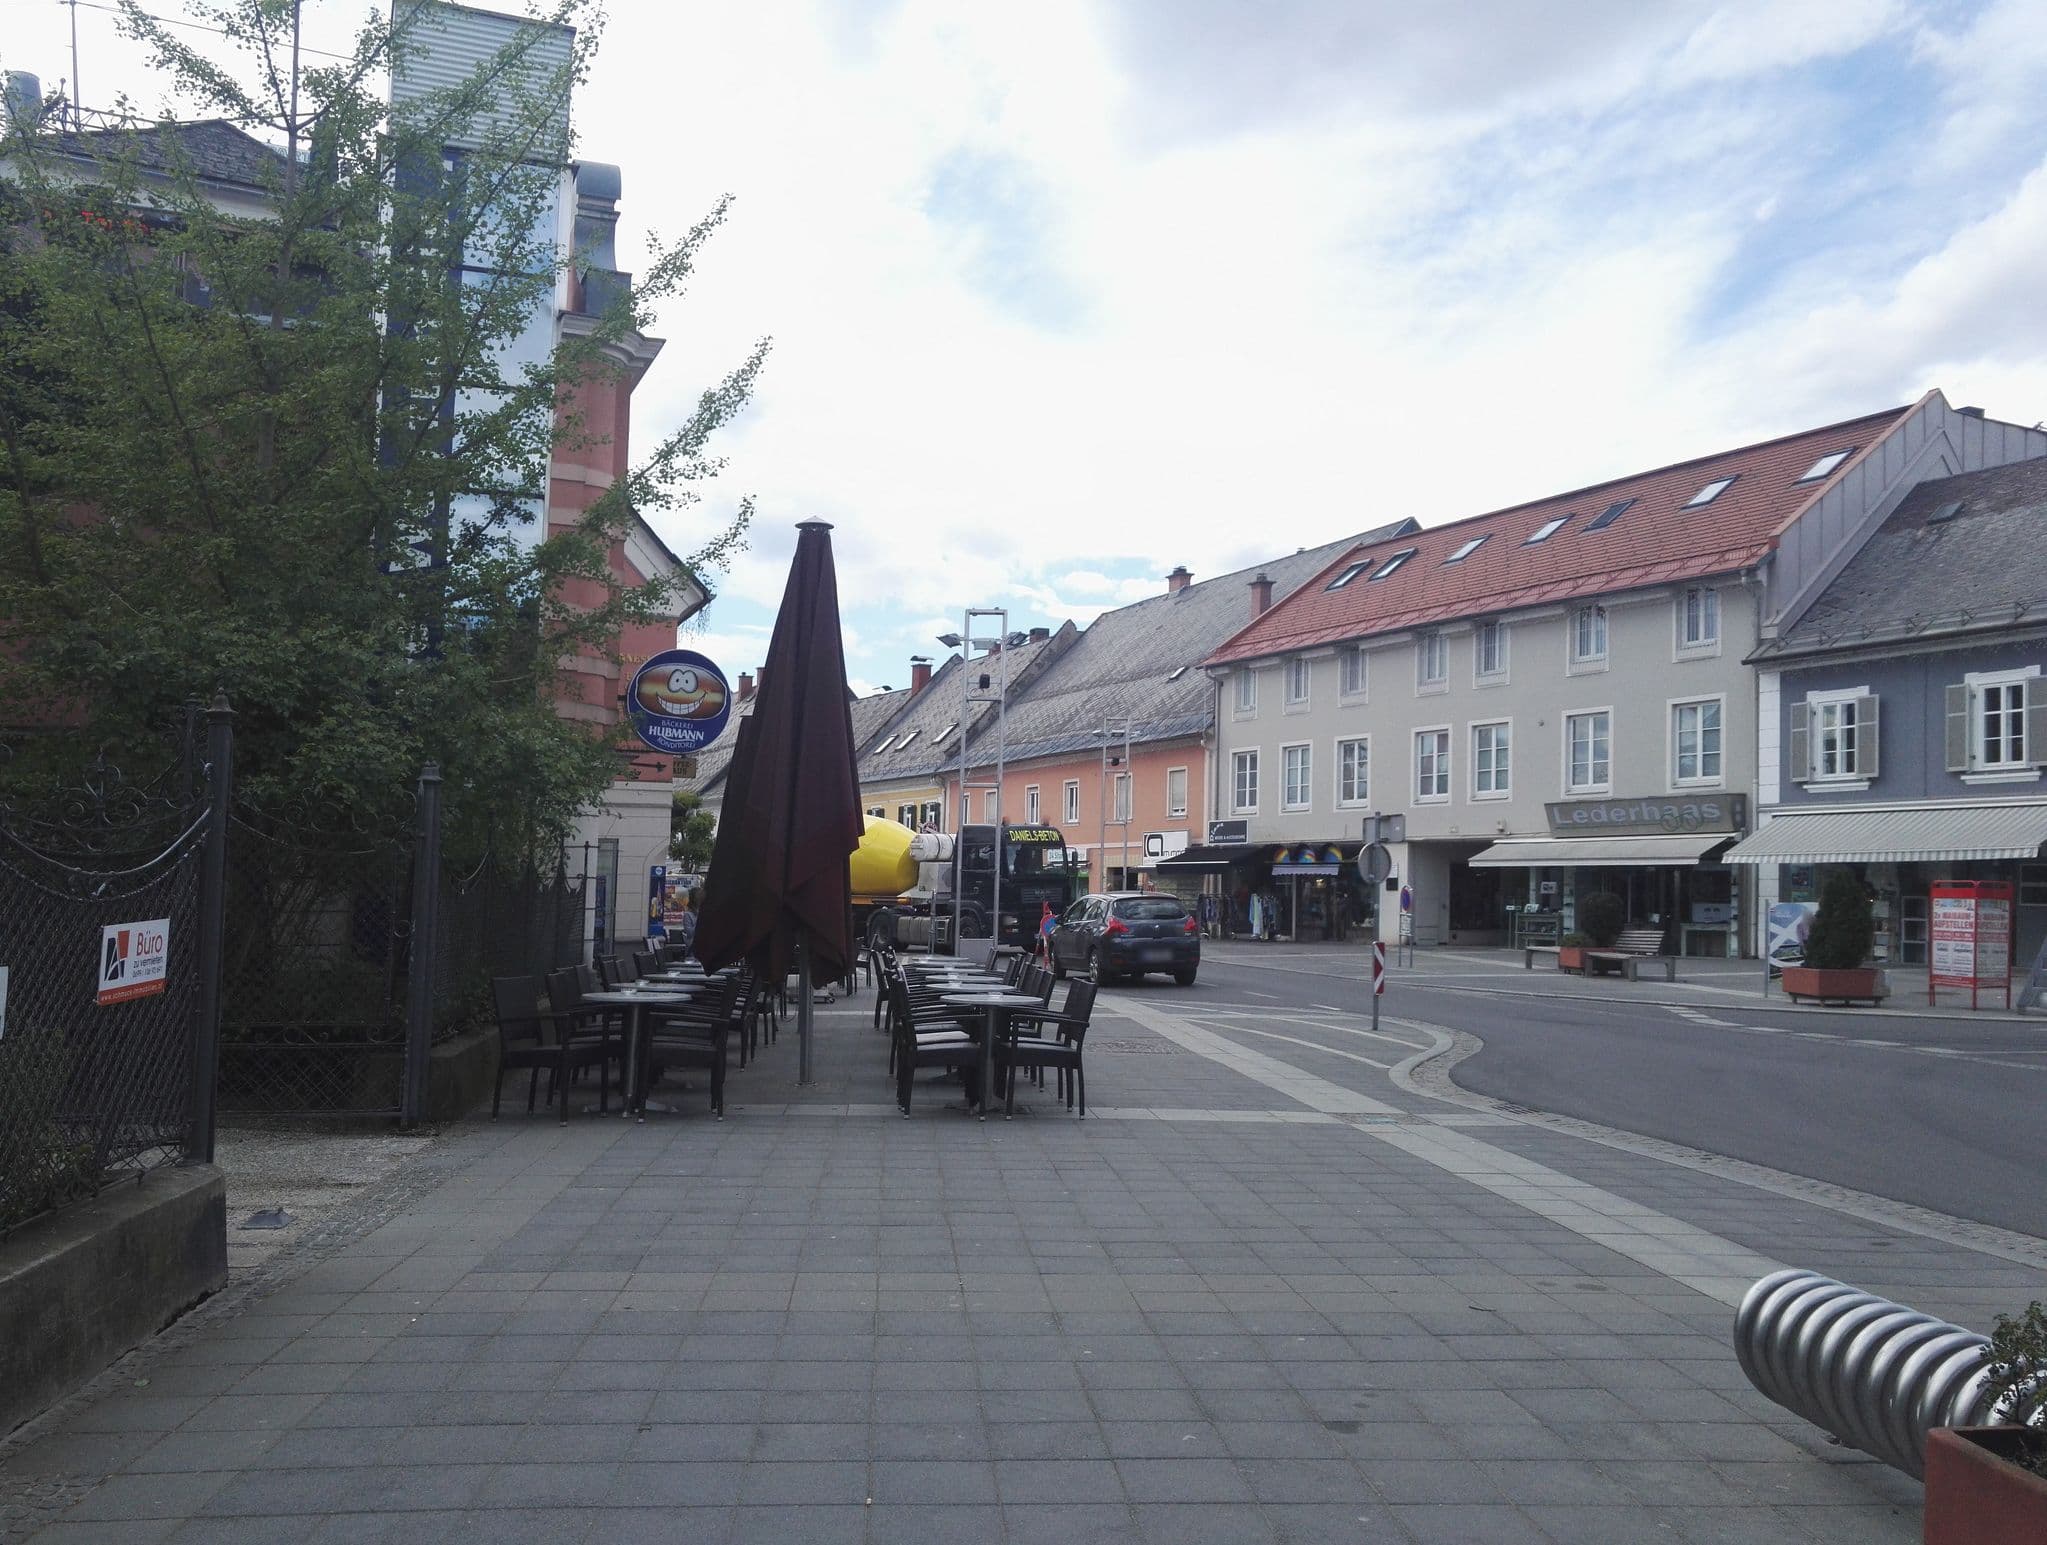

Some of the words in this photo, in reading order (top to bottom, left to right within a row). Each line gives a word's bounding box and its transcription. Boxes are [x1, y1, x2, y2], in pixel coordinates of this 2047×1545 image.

[661, 719, 694, 729] BÄCKEREI
[649, 725, 704, 741] HUBMANN
[657, 737, 696, 749] KONDITOREI
[1552, 802, 1721, 824] Lederhaas
[1009, 830, 1060, 842] DANIELS-BETON
[136, 930, 163, 956] Büro
